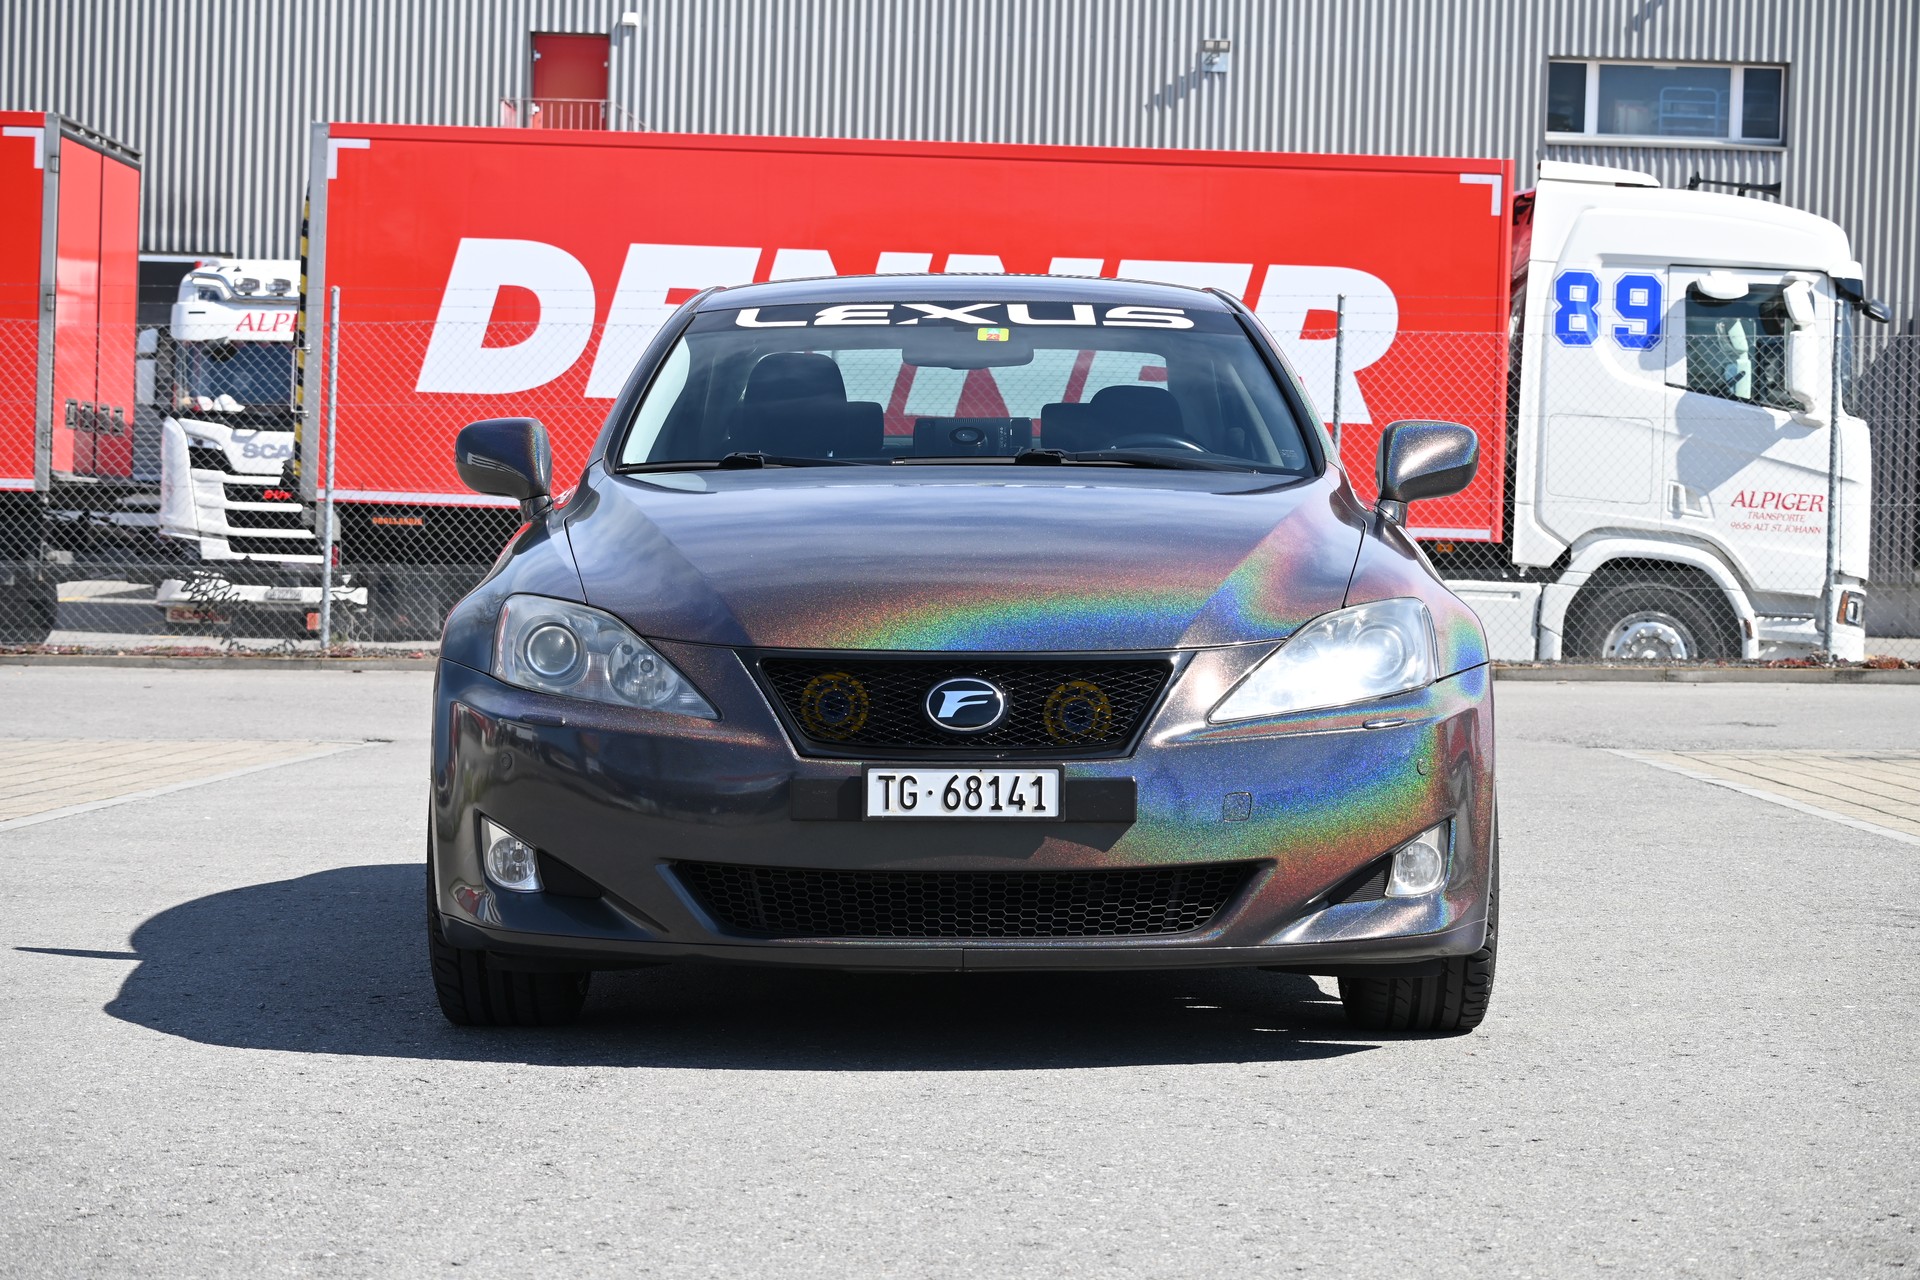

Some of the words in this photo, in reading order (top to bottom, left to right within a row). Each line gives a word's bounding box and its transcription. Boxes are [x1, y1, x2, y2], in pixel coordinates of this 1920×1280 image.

[734, 302, 1196, 329] LEXUS
[1552, 268, 1664, 351] 89
[1730, 490, 1824, 512] ALPIGER
[1747, 511, 1806, 522] TRANSPORTE
[1753, 523, 1770, 532] ALT
[1784, 525, 1822, 535] JOHANN
